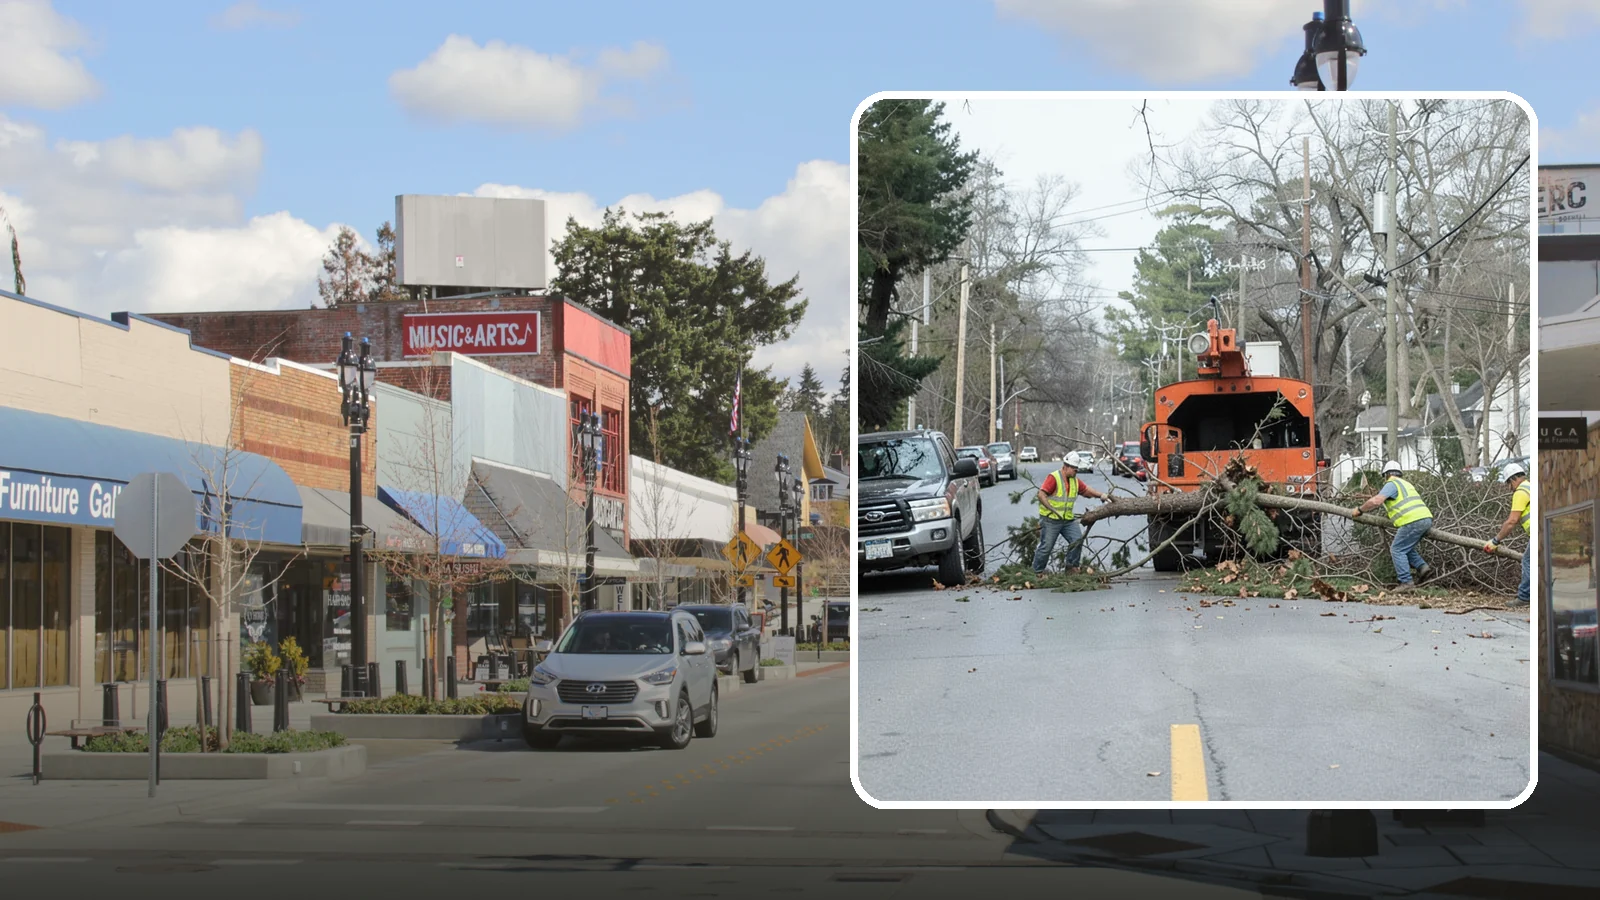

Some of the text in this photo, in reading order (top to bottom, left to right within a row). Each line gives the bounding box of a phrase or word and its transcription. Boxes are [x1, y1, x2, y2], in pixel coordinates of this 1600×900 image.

[408, 322, 520, 349] MUSIC&ARTS
[1540, 427, 1577, 437] UGA
[0, 471, 121, 519] Furniture Gal
[453, 564, 479, 574] SUSHI
